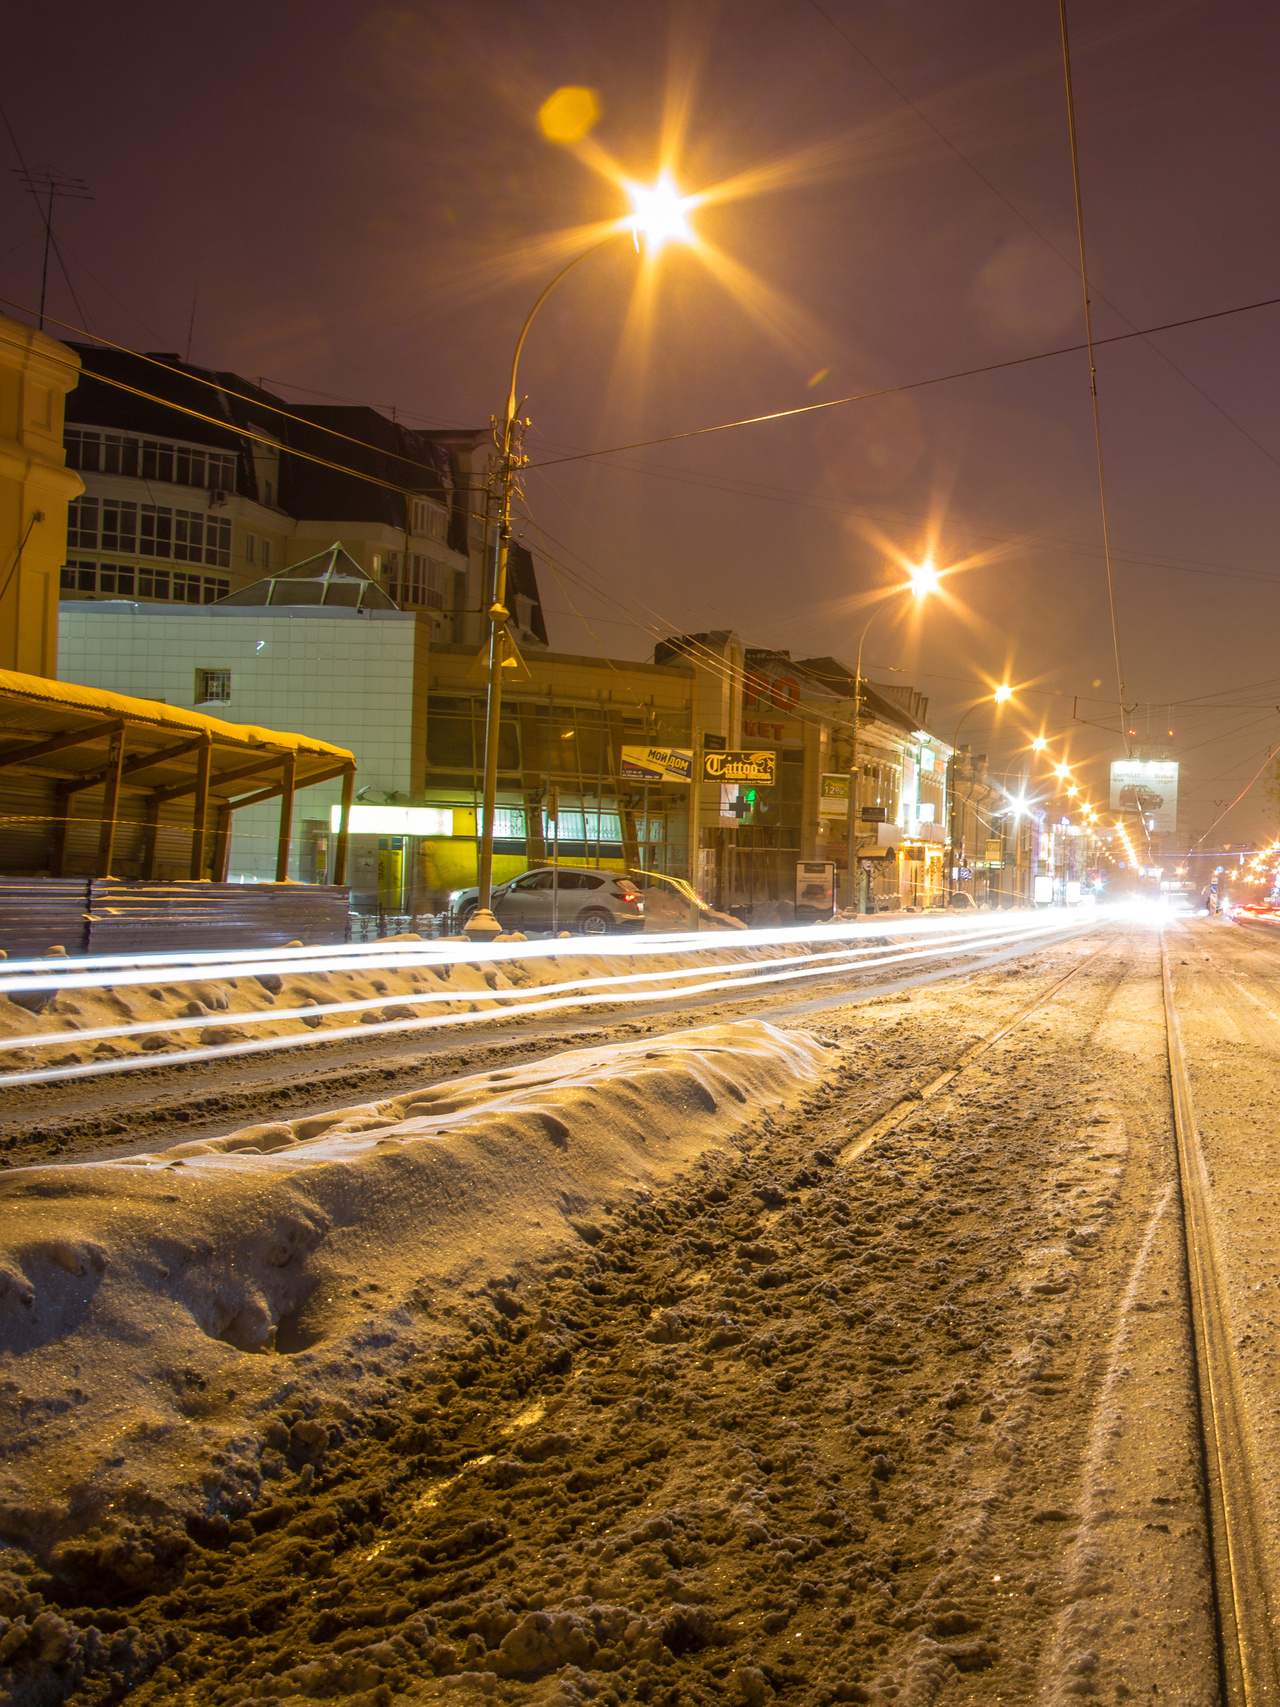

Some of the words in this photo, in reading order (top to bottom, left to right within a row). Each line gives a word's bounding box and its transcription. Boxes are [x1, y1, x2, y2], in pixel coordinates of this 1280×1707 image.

[742, 671, 800, 711] РО
[742, 720, 785, 741] КЕТ
[647, 749, 668, 763] МОЙ
[667, 756, 689, 771] ДОМ
[705, 754, 758, 776] Tattoo
[824, 786, 845, 796] 12%
